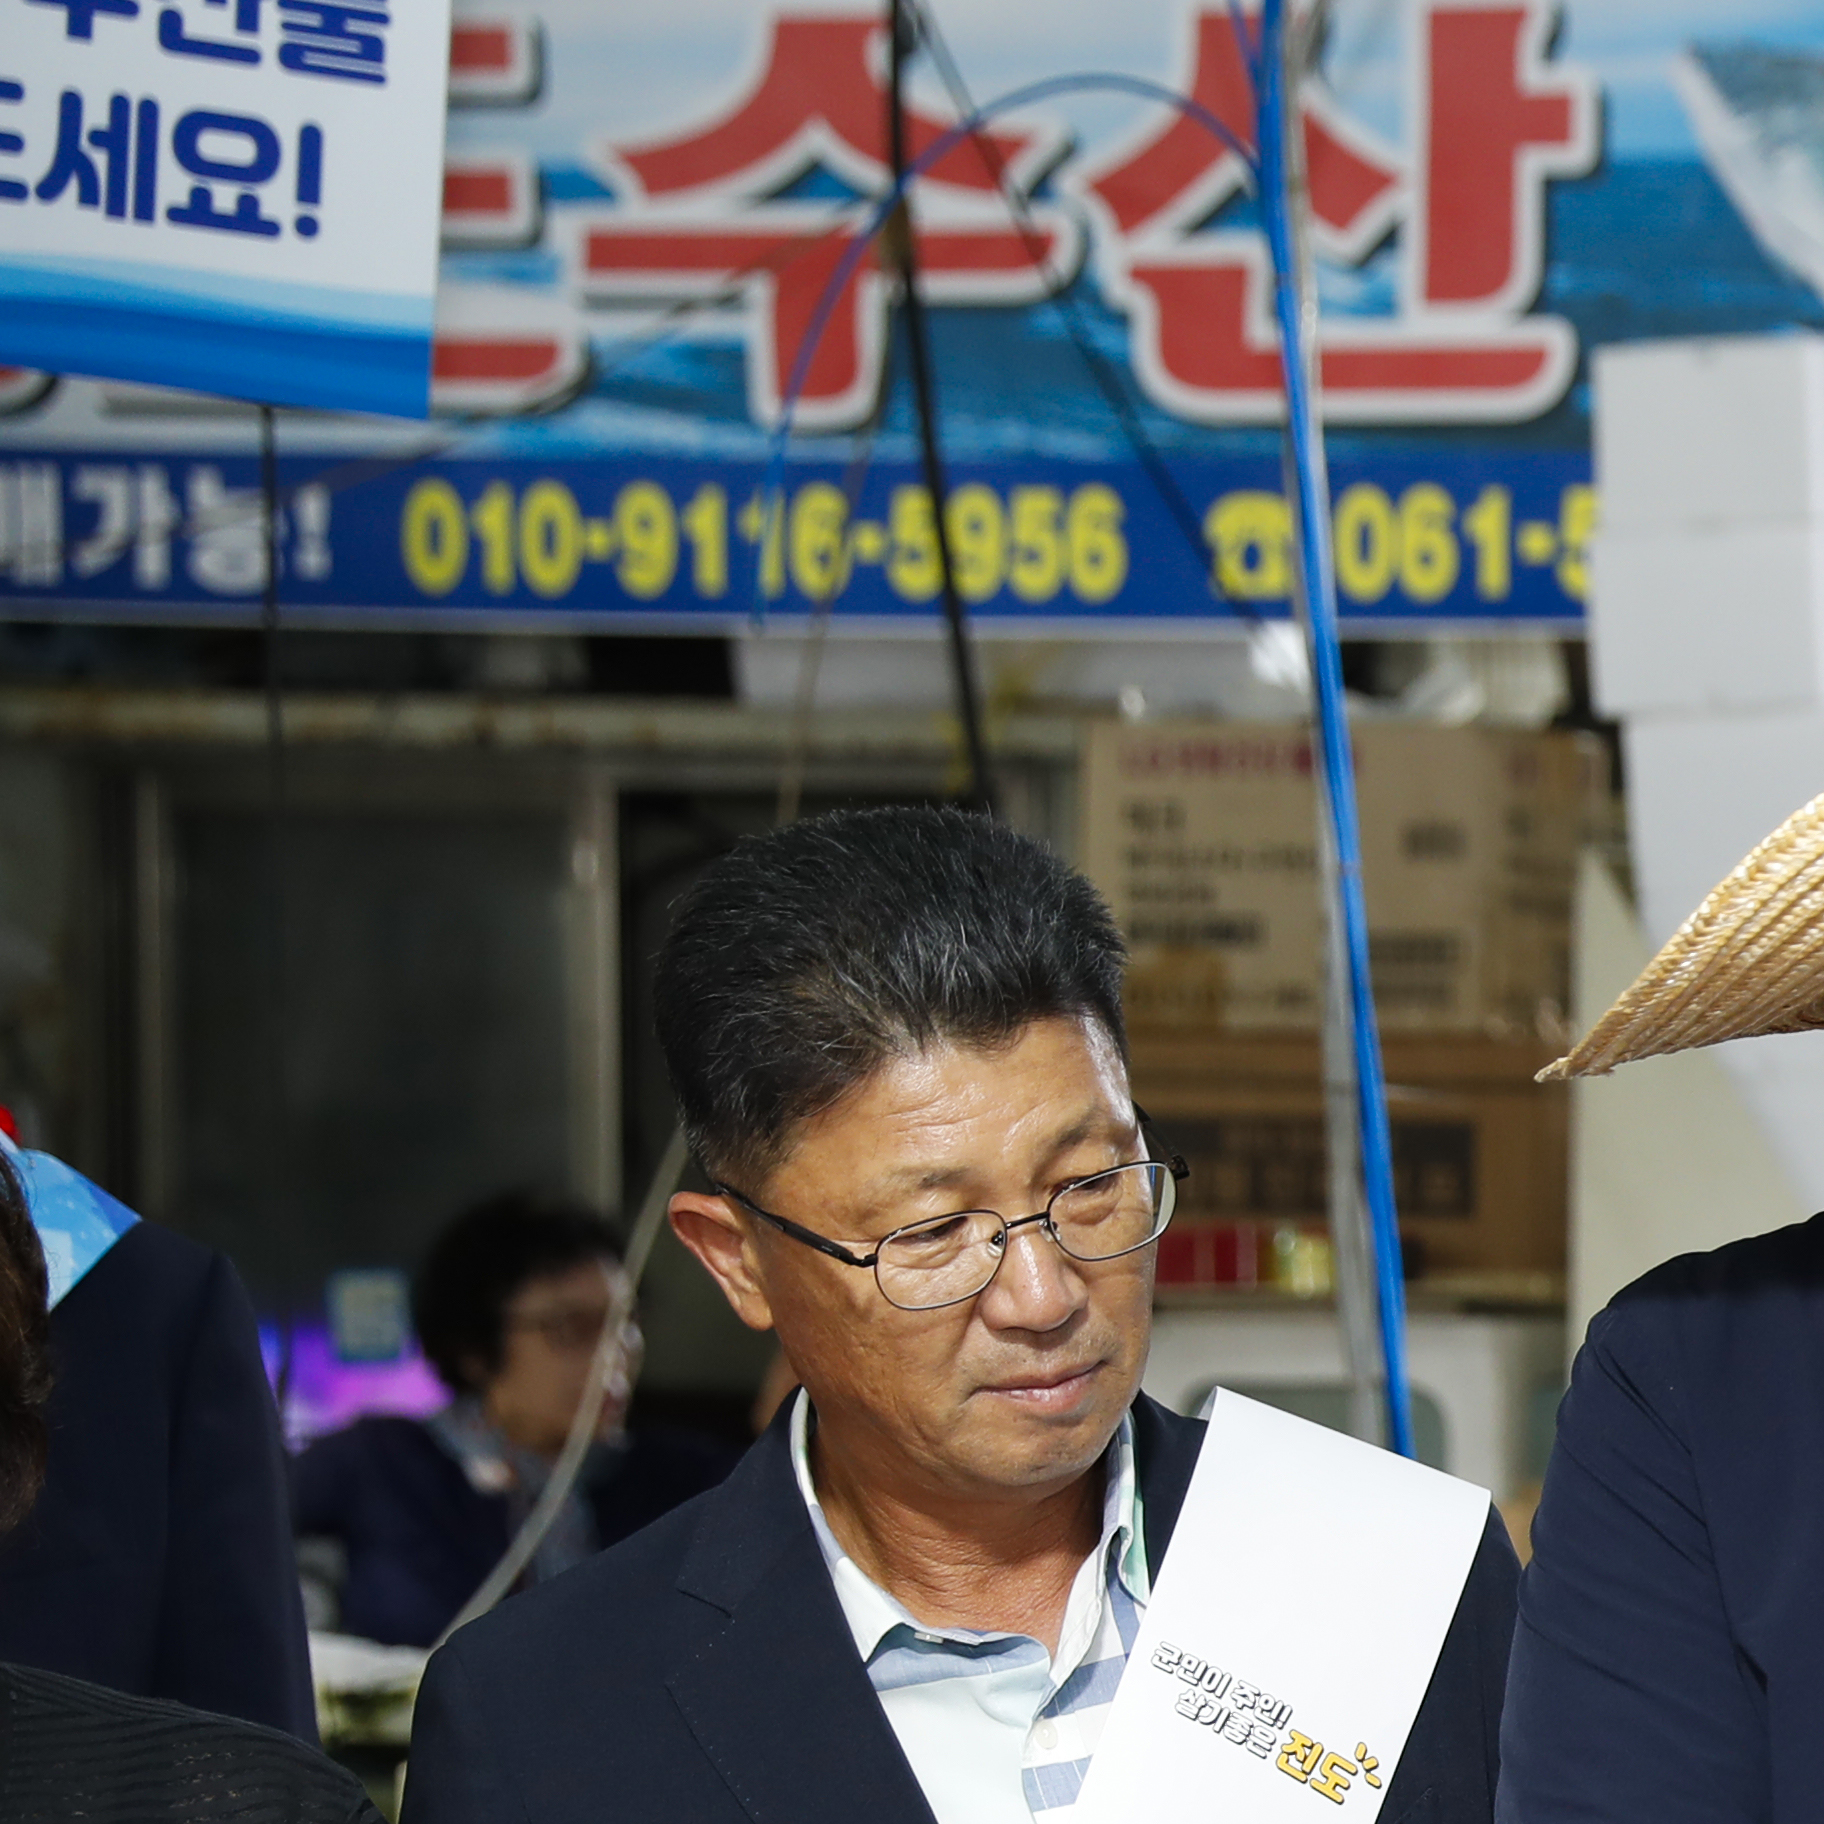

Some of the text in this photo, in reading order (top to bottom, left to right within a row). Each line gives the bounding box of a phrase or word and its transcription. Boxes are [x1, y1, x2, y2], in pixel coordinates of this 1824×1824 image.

[0, 83, 324, 238] 세요!
[440, 0, 1580, 405] 수산
[402, 478, 1130, 605] 010-9116-5956
[1150, 1641, 1294, 1730] 군민이 주인!
[1275, 1729, 1358, 1805] 진도
